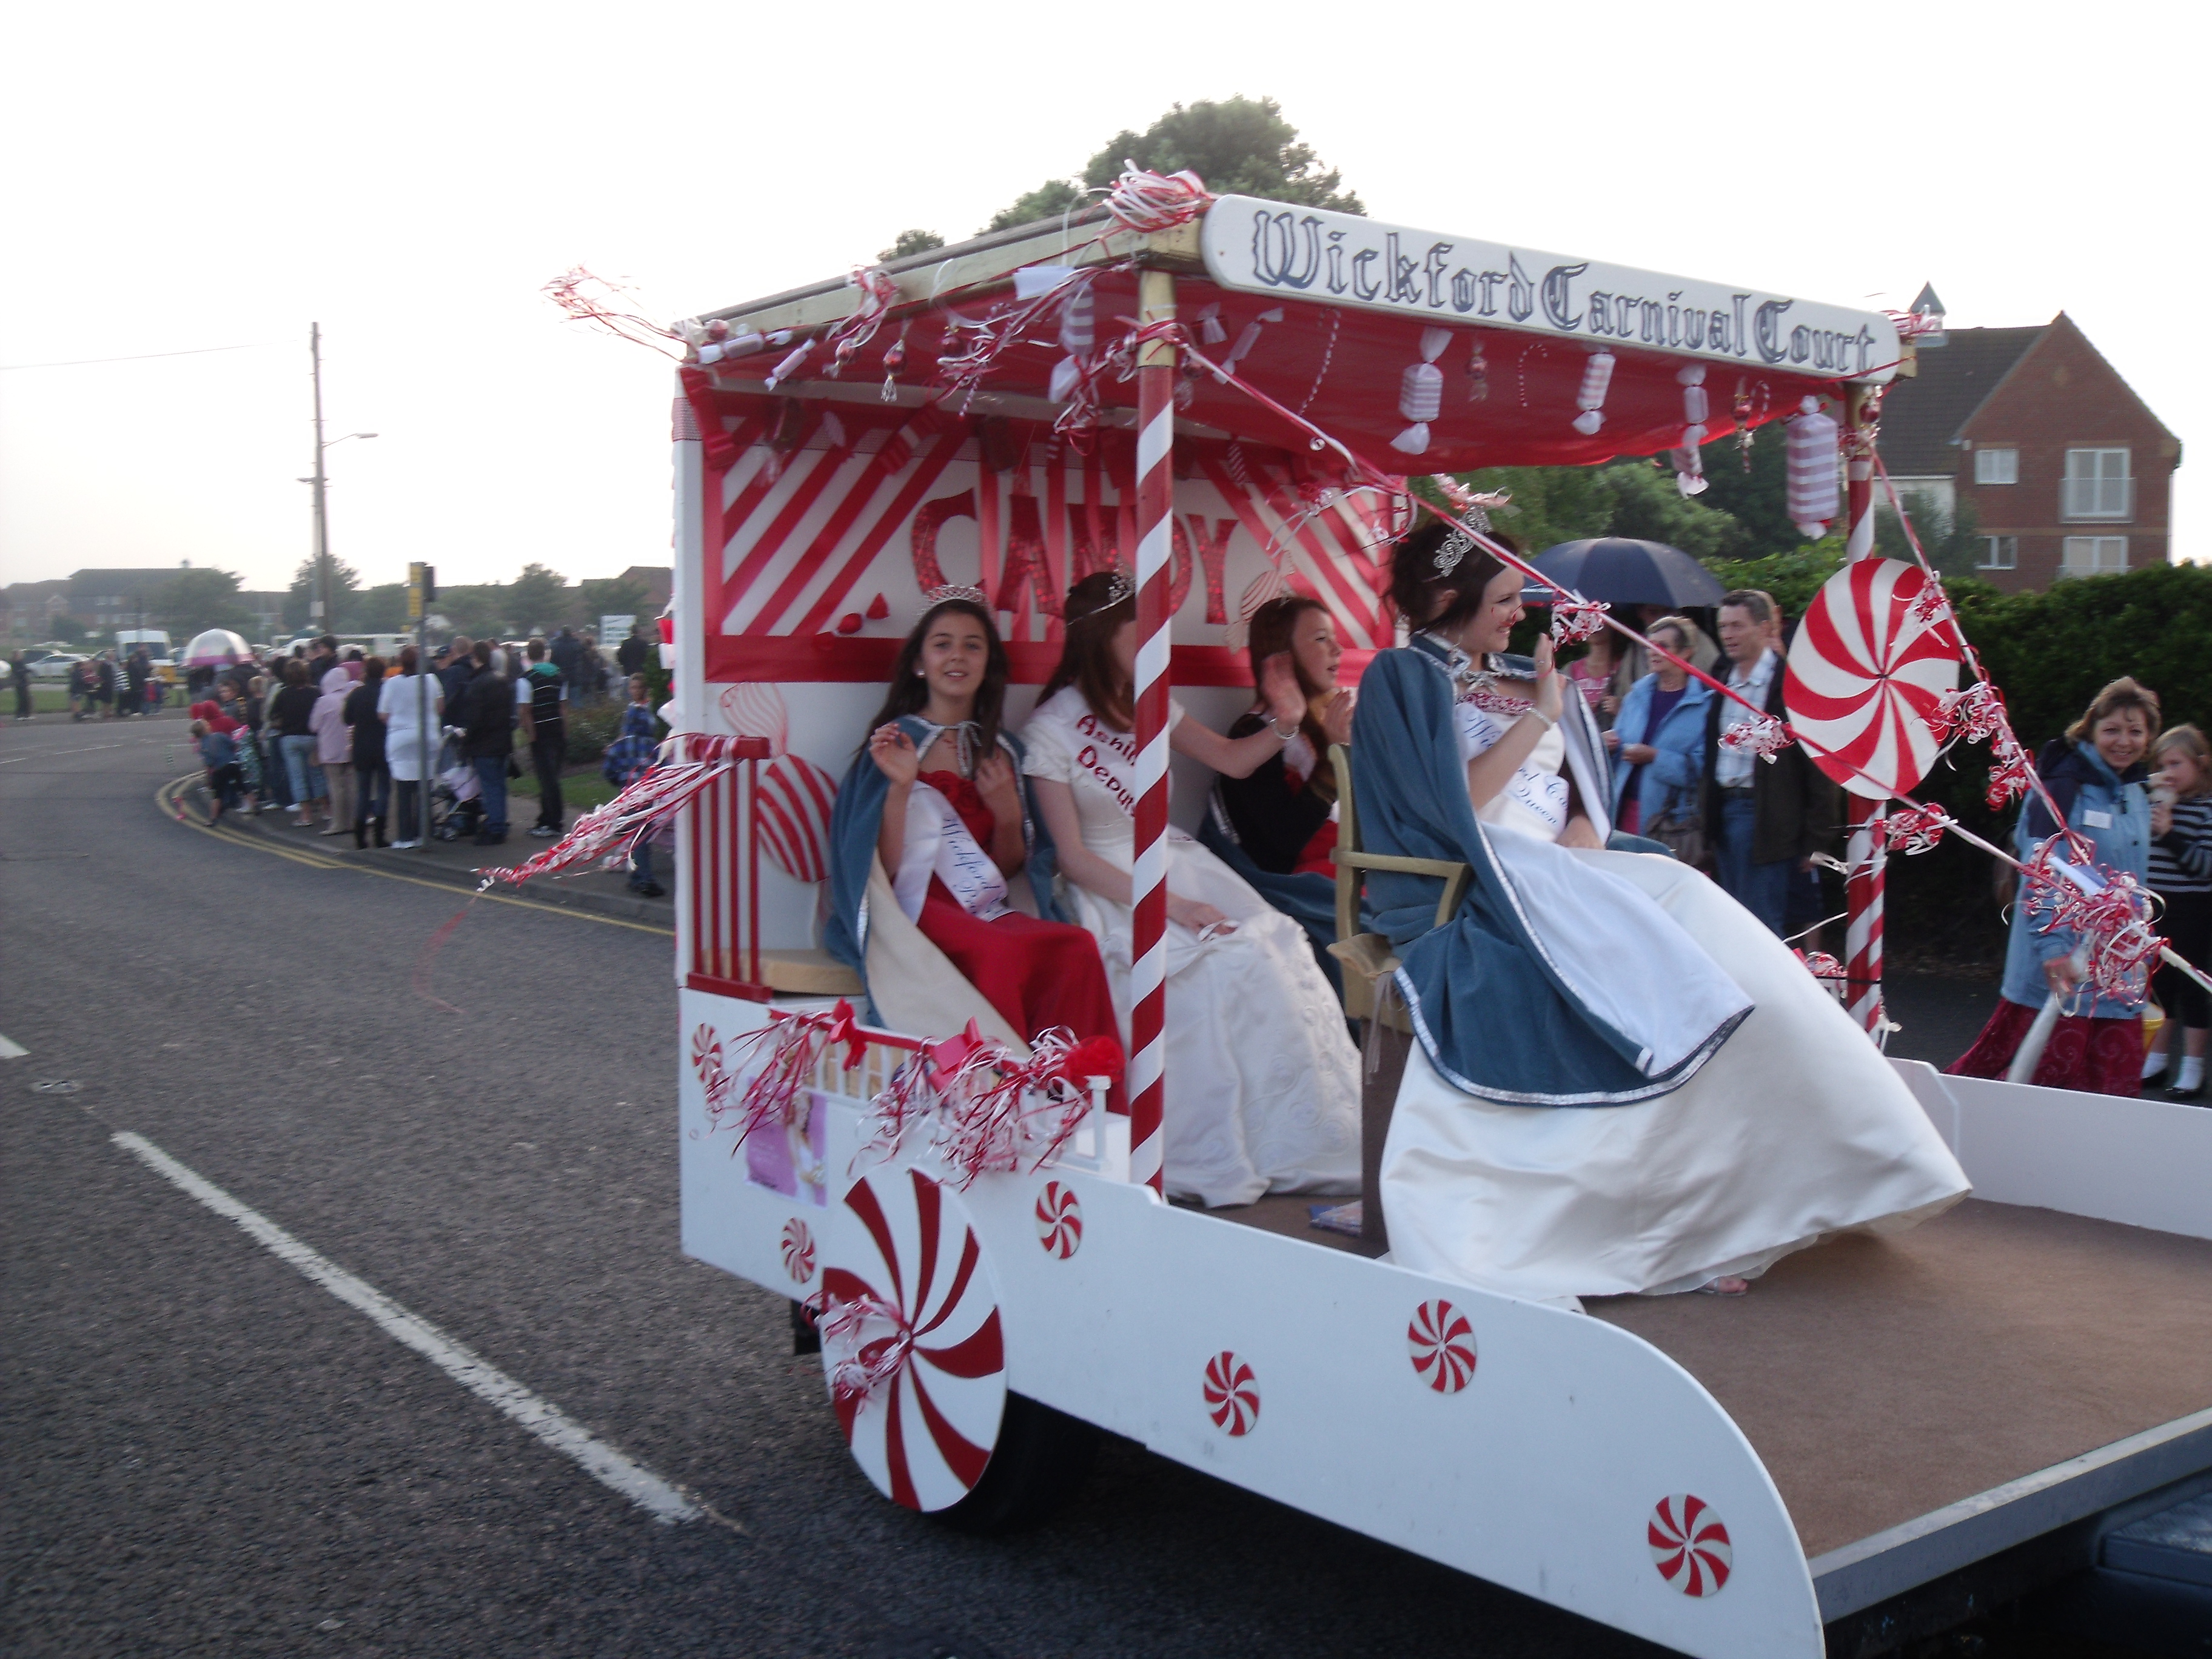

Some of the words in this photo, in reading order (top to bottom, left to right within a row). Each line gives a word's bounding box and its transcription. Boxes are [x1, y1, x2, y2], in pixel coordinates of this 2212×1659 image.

[1252, 210, 1535, 323] Wickford
[1541, 262, 1752, 357] Carnival
[1754, 299, 1877, 378] Court
[1077, 745, 1136, 817] Deput
